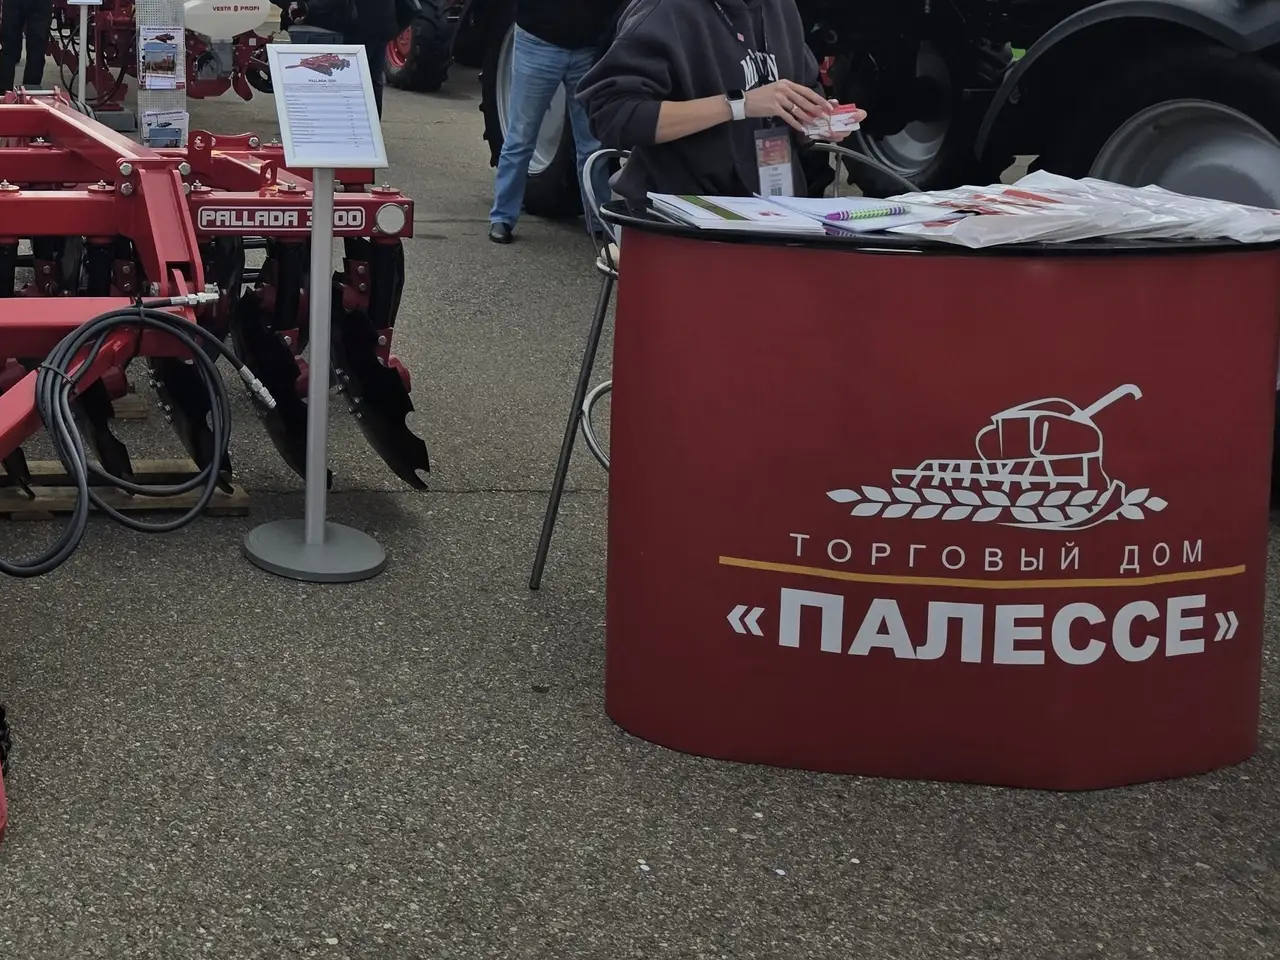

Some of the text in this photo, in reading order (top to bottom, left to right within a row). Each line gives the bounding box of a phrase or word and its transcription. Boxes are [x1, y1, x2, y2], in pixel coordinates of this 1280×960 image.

[201, 210, 298, 227] PALLADA
[789, 533, 1204, 574] ТОРГОВЫЙ ДОМ
[726, 587, 1239, 666] «ПАЛЕССЕ»
